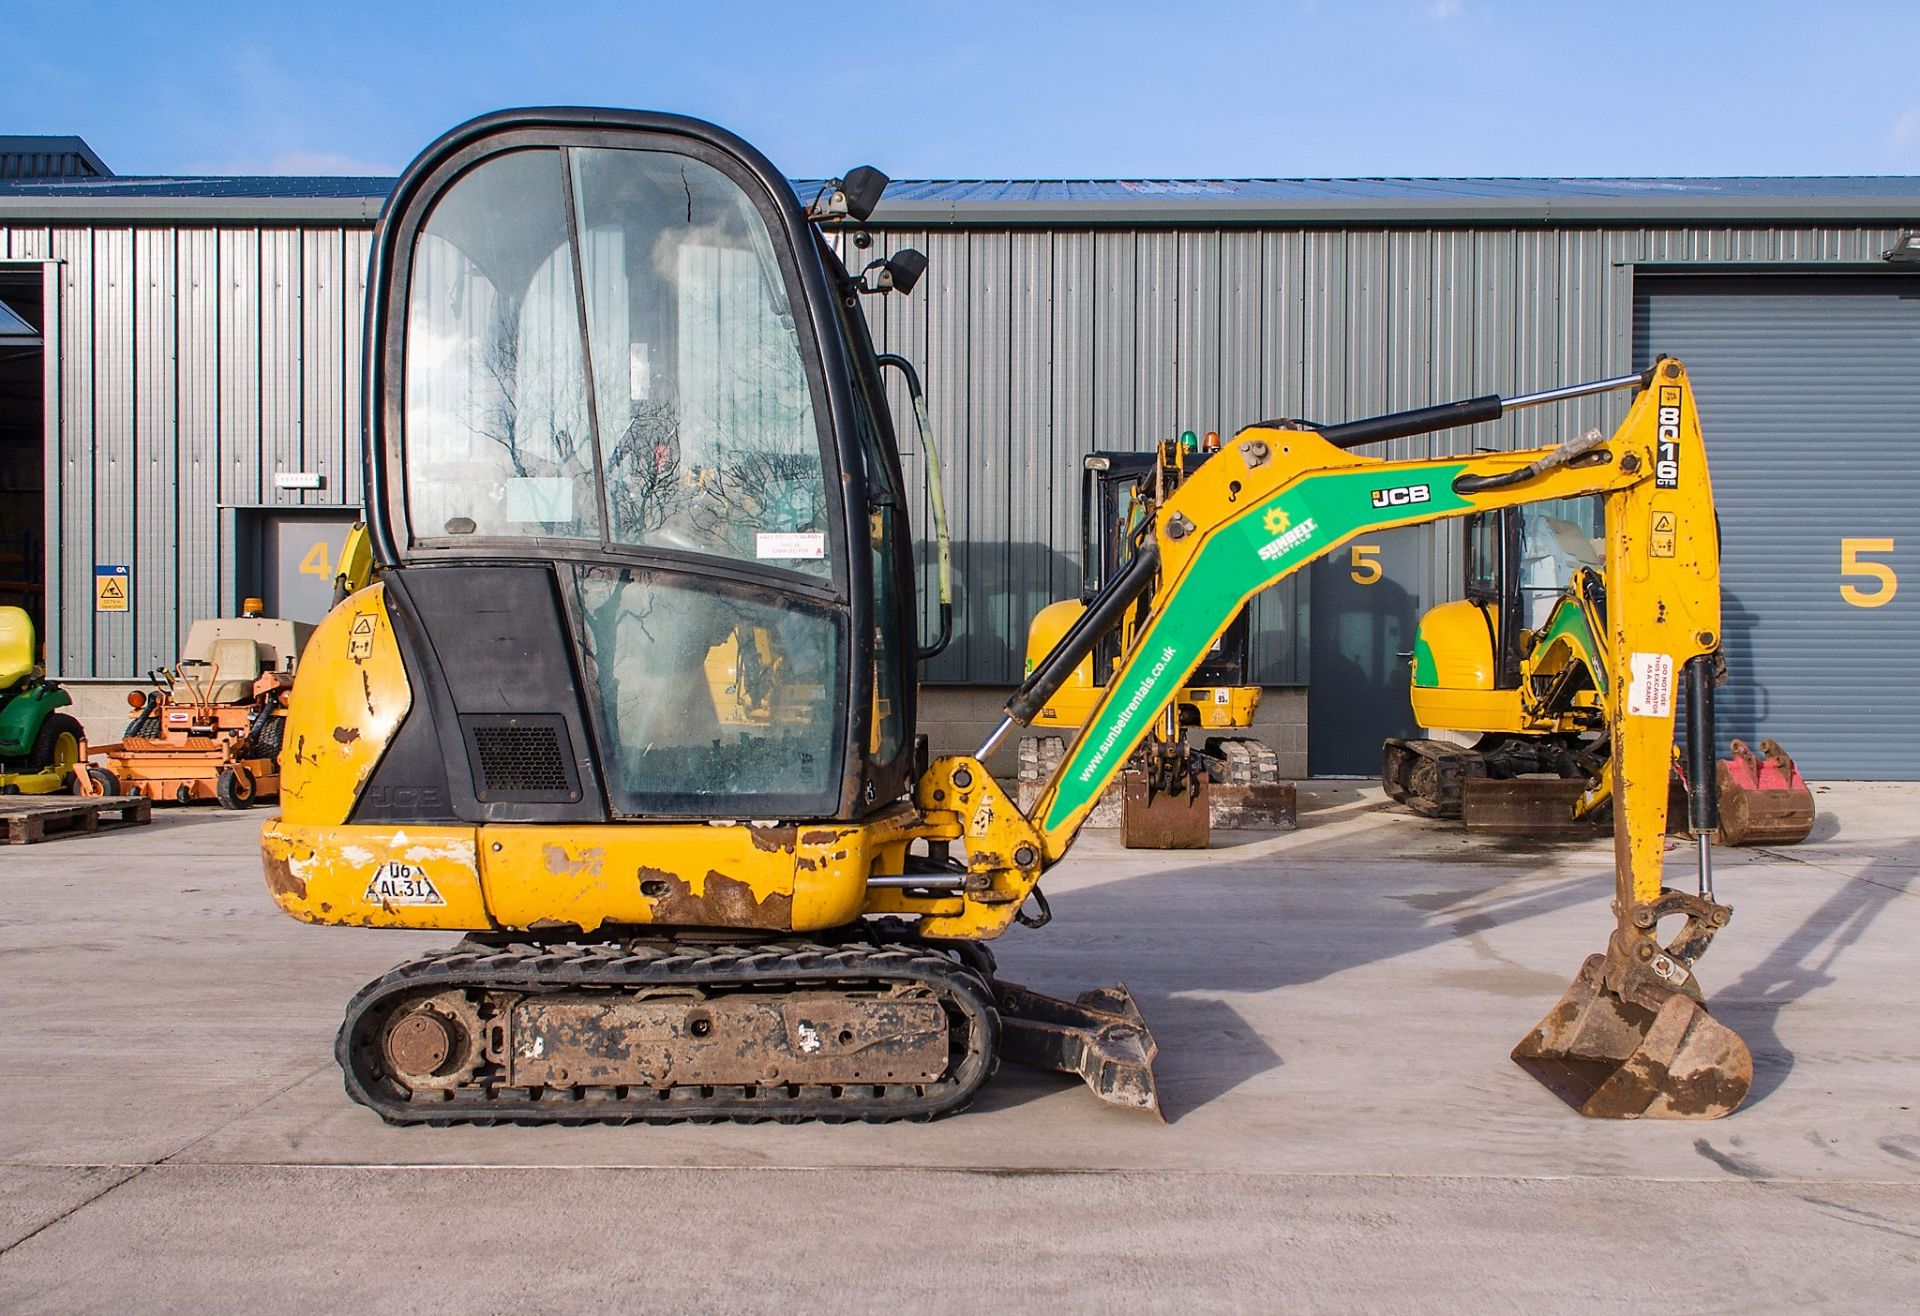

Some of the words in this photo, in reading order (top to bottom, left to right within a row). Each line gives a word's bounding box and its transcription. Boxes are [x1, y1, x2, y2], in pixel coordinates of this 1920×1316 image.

[1657, 407, 1680, 478] 8016
[1372, 485, 1431, 507] JCB
[1258, 517, 1317, 560] SUNBELT
[1271, 533, 1312, 560] RENTALS
[299, 542, 332, 581] 4
[1350, 545, 1383, 585] 5
[1840, 538, 1897, 608] 5
[1647, 664, 1653, 674] AS
[1662, 664, 1668, 675] DO
[1652, 673, 1660, 714] EXCAVATOR
[1079, 646, 1177, 782] www.sunbeltrentals.co.uk
[370, 786, 442, 808] JCB
